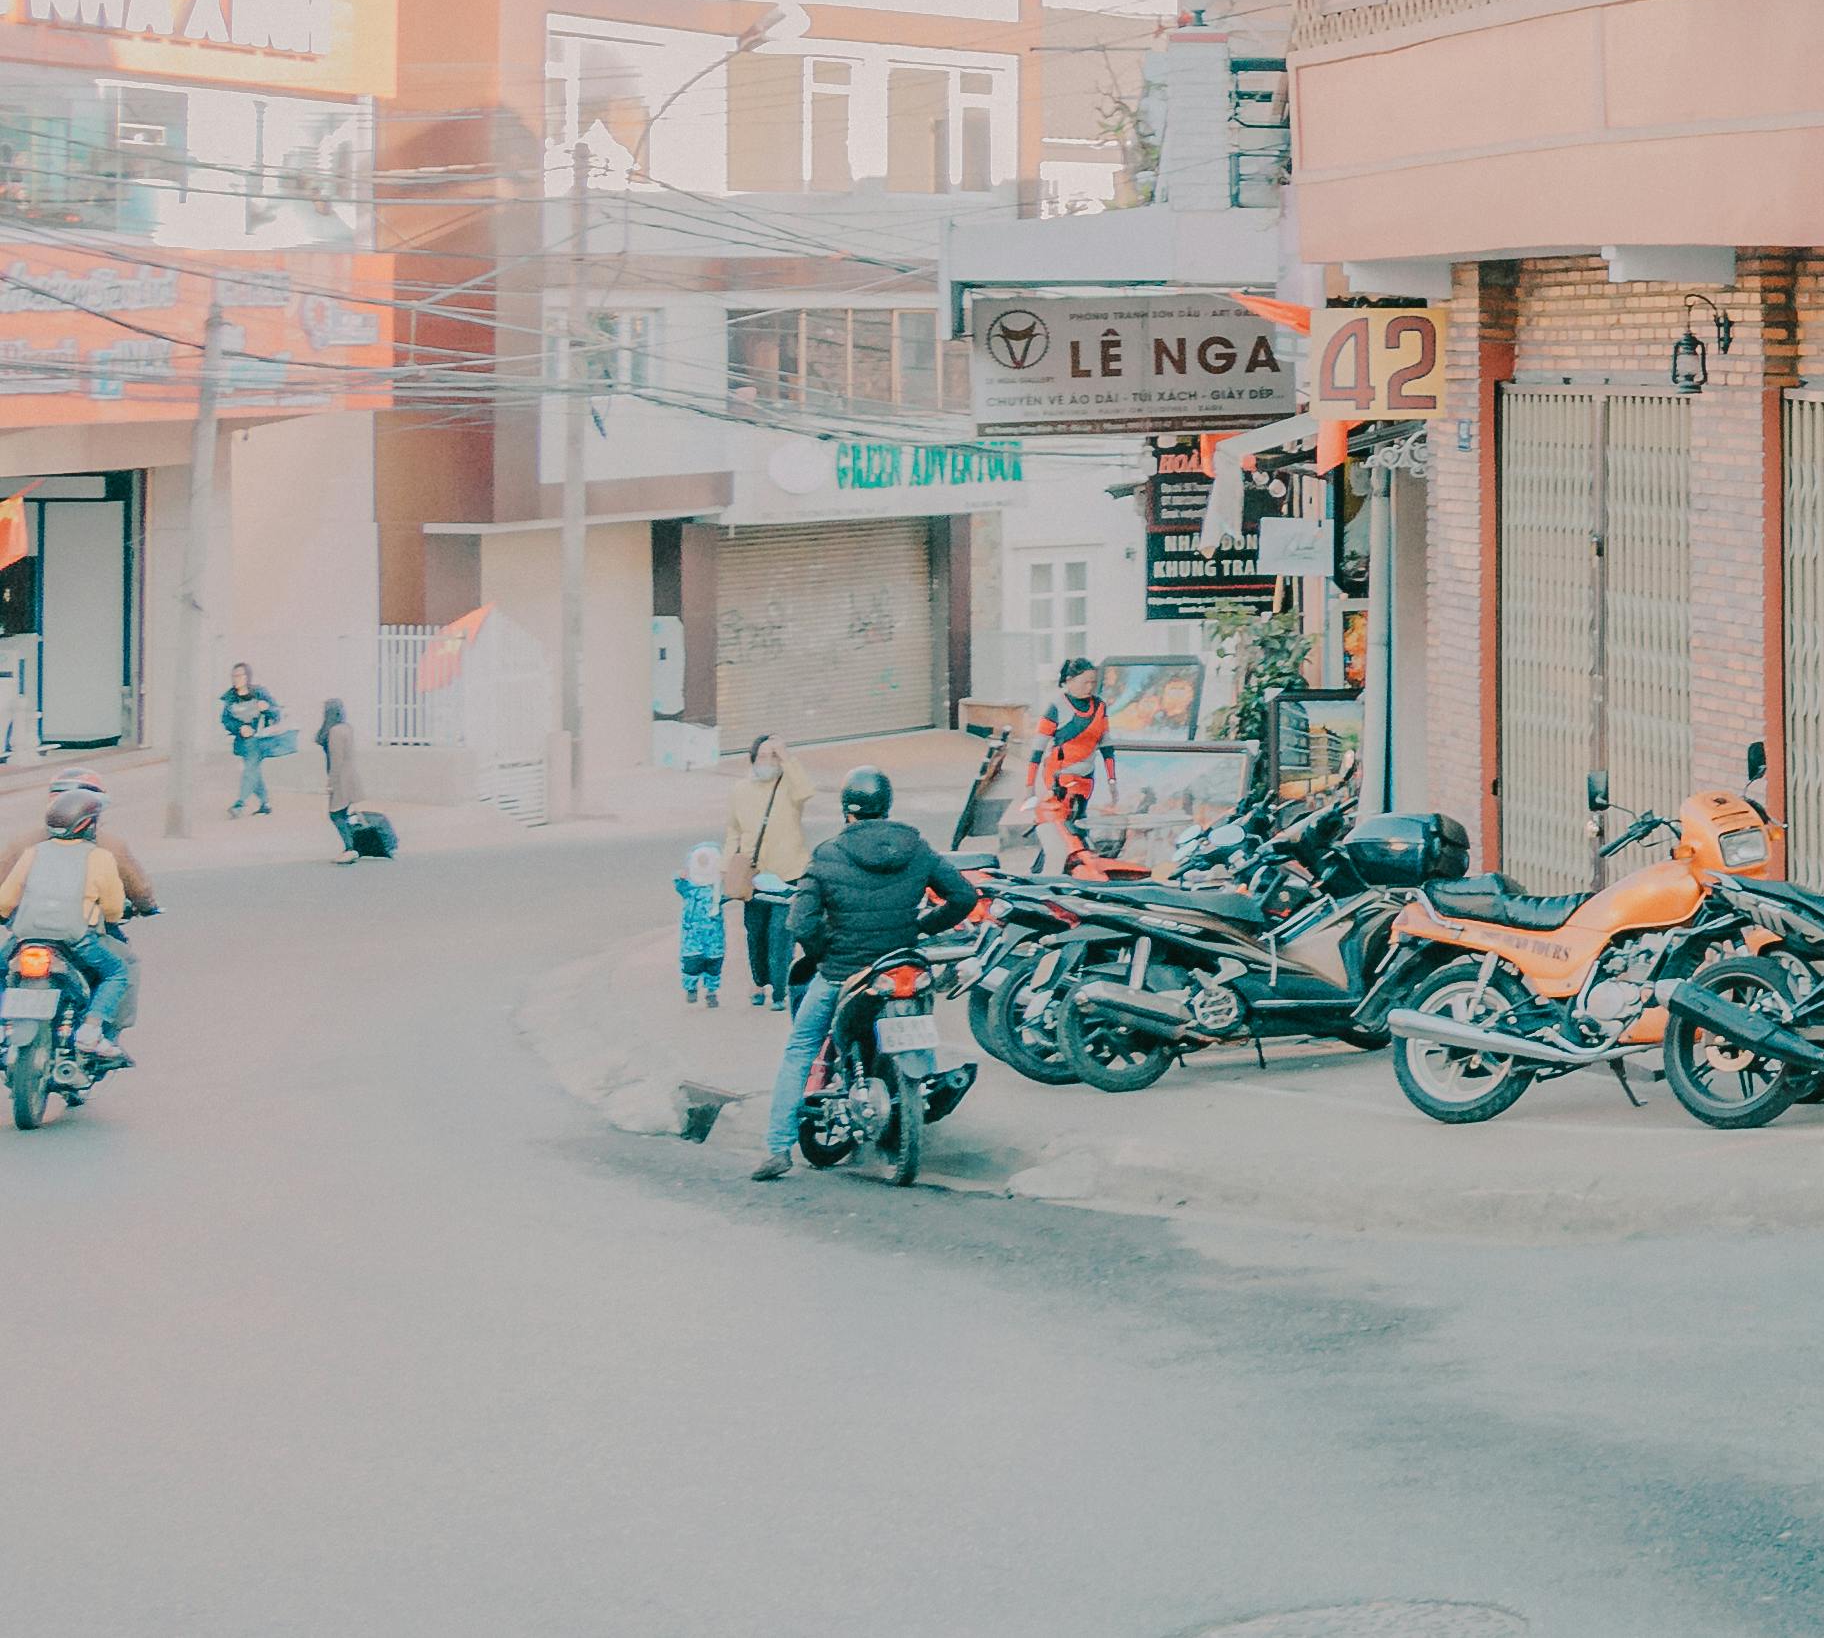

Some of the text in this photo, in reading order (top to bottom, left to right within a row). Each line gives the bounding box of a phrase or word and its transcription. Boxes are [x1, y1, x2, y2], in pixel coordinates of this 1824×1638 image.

[1069, 328, 1281, 378] LÊ NGA
[1319, 315, 1437, 410] 42
[836, 441, 901, 489] GREEN
[1153, 560, 1217, 578] KHUNG
